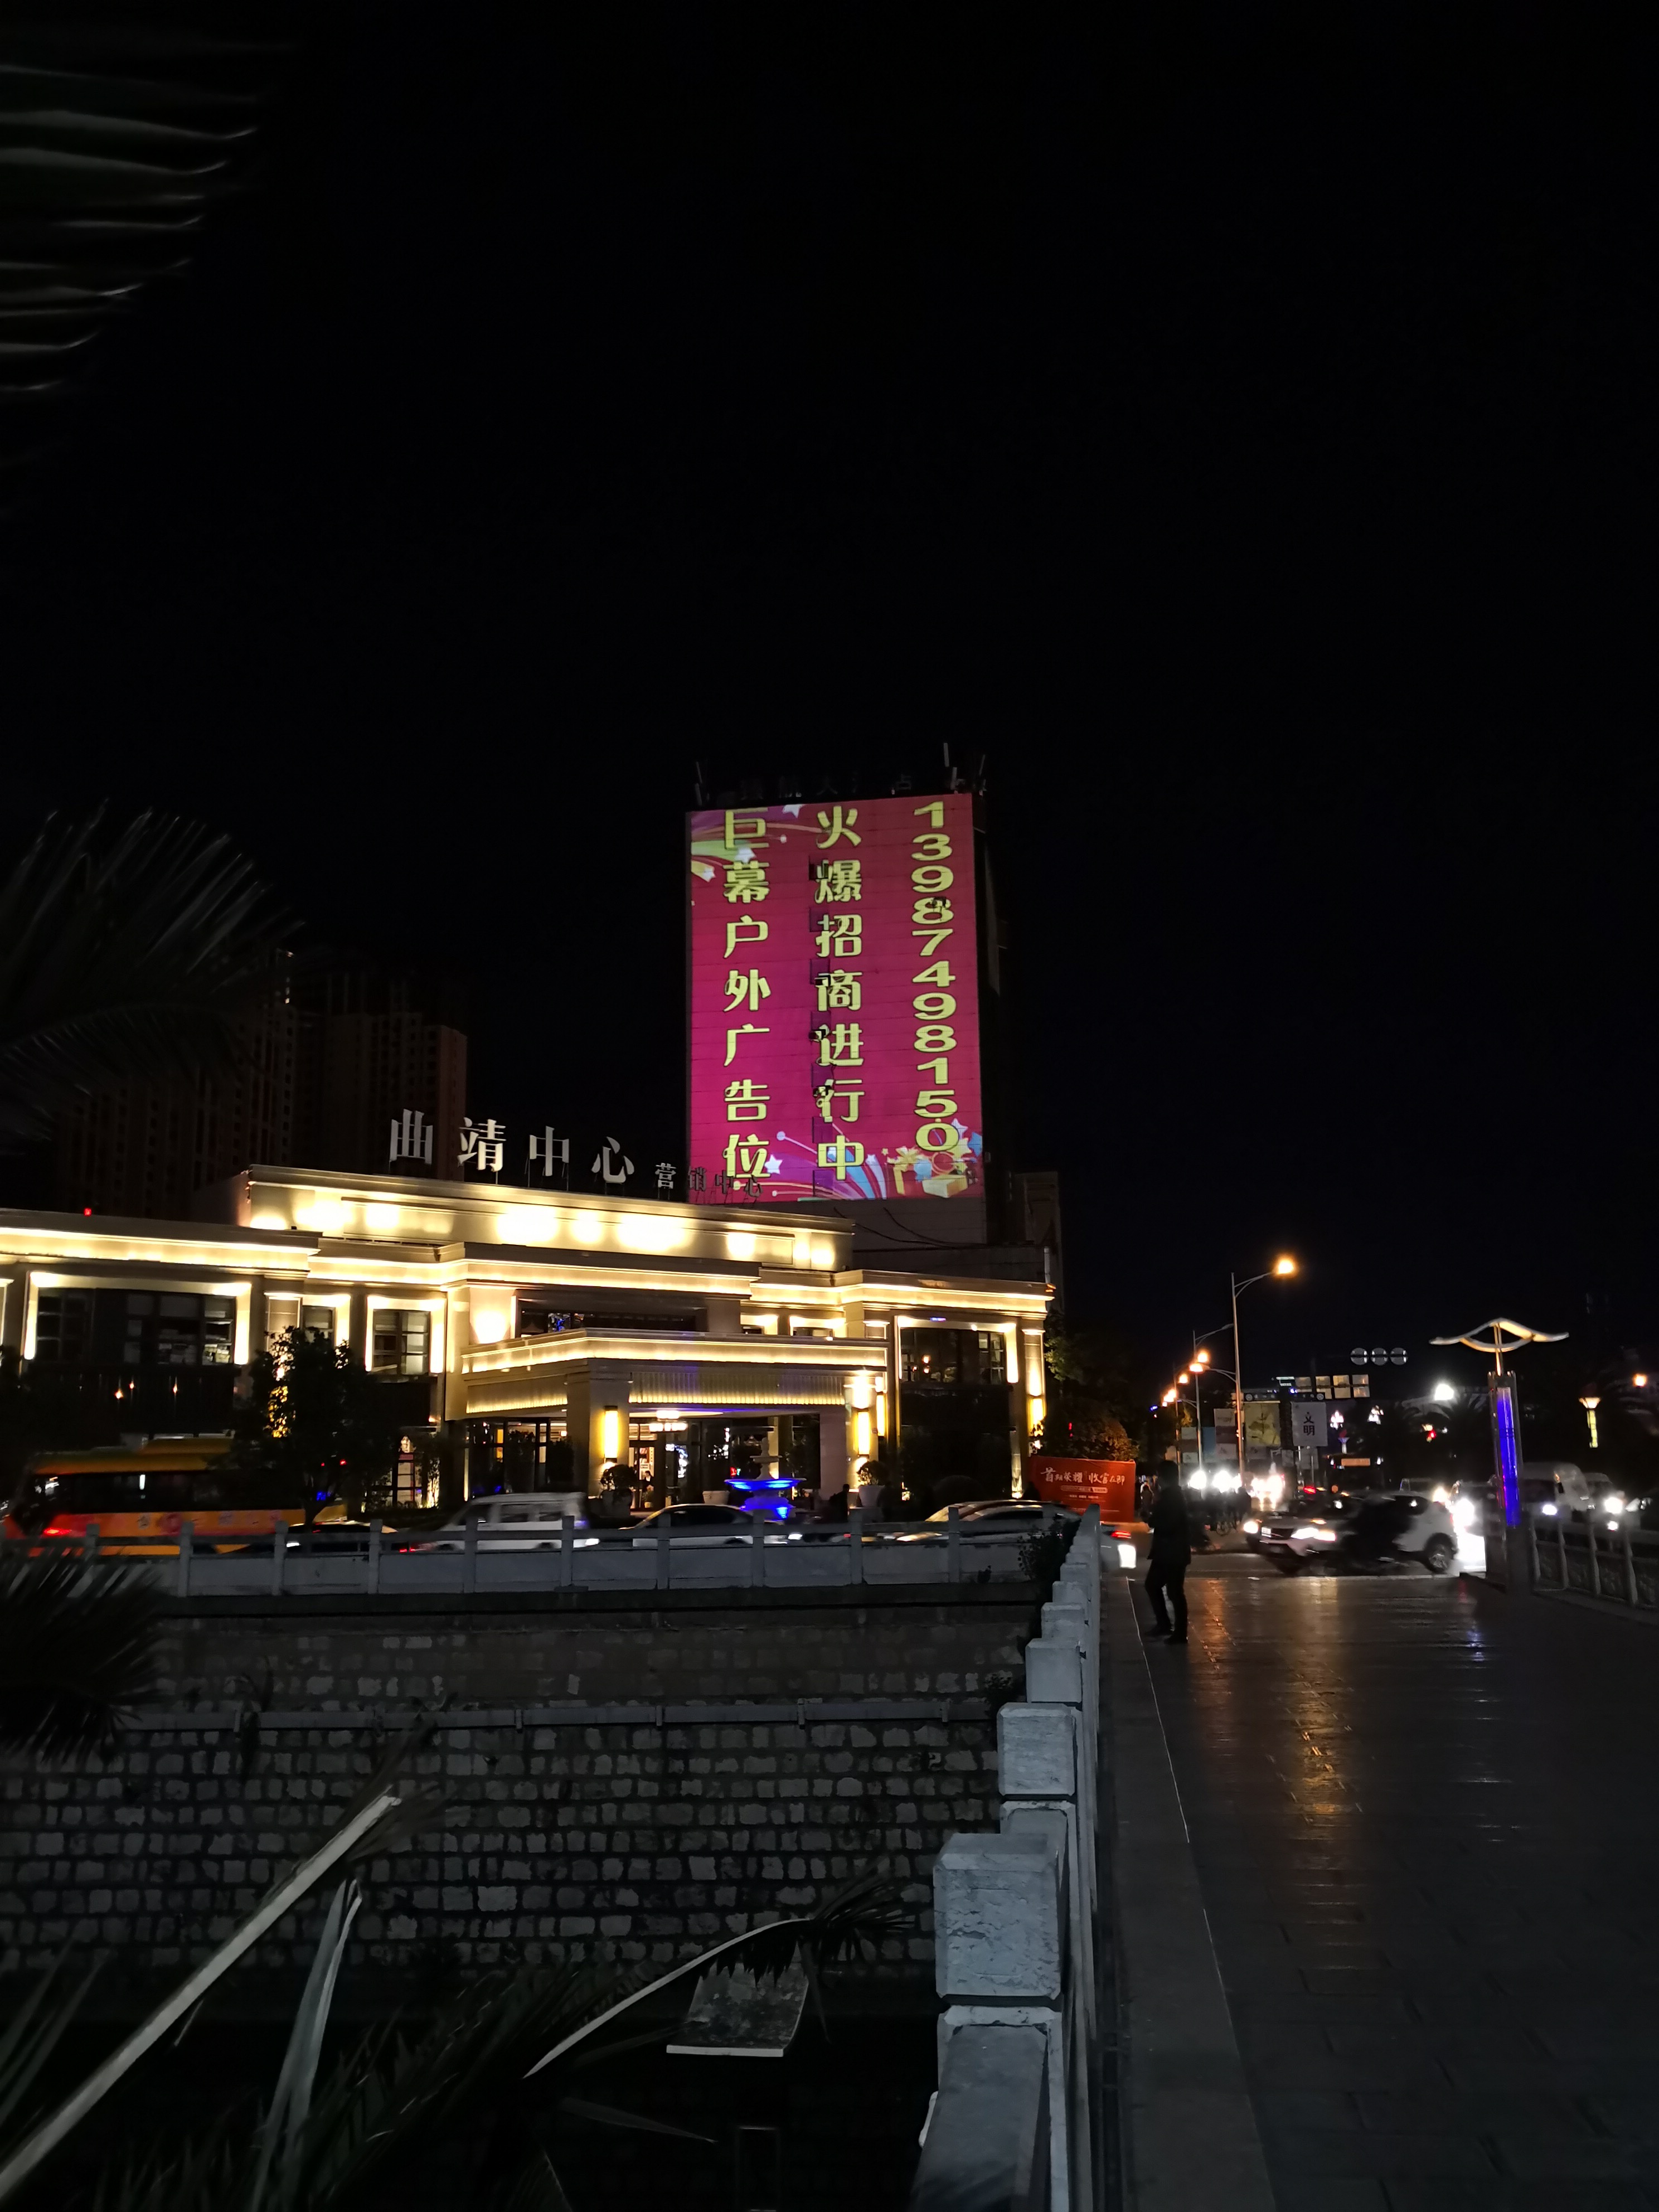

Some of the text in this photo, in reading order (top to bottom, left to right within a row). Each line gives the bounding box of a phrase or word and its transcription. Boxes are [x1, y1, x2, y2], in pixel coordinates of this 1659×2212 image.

[723, 807, 772, 1179] 巨幕户外广告位
[816, 805, 865, 1181] 火爆招商进行中
[911, 801, 959, 1152] 13987498150
[389, 1108, 763, 1197] 曲靖中心 营销中心
[1303, 1411, 1316, 1437] 文明
